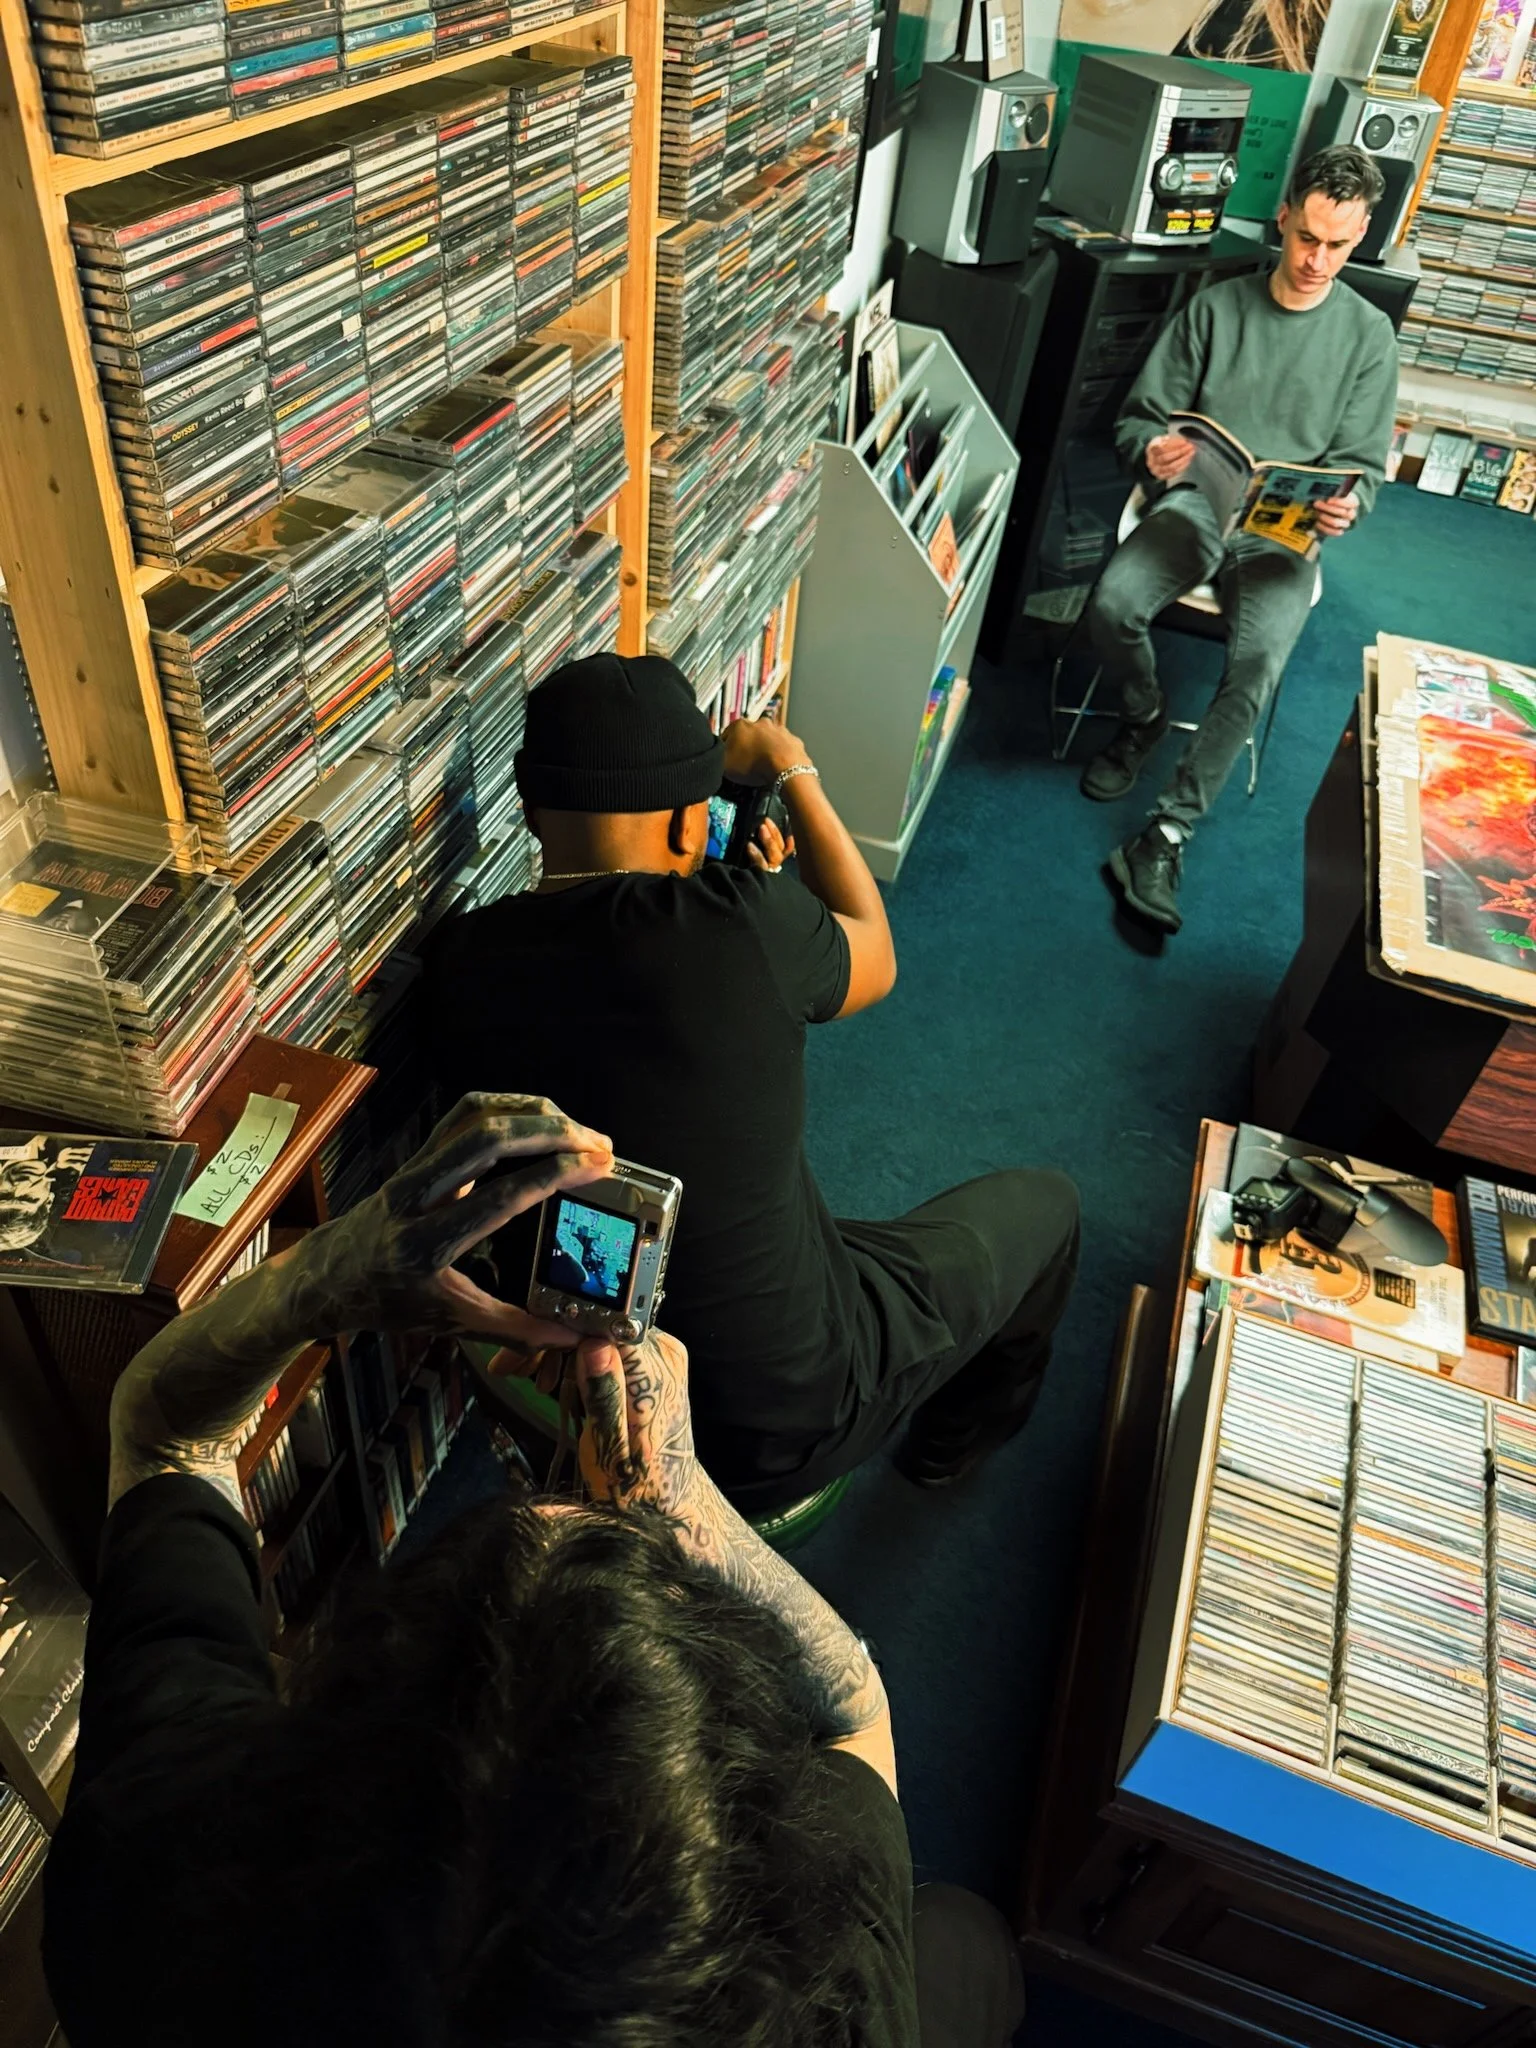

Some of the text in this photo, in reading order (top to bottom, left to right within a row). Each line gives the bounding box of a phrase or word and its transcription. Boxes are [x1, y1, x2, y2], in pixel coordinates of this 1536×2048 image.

[169, 420, 201, 443] ODYSSEY
[202, 407, 221, 424] Kevin
[36, 863, 107, 893] WOW
[75, 1175, 149, 1204] GAMES
[200, 1183, 231, 1217] ALL
[60, 1195, 140, 1222] PATRIOT
[1464, 1175, 1509, 1291] NEIL DIAMOND
[1479, 1285, 1536, 1335] STA
[622, 1349, 656, 1413] WBC
[27, 1701, 62, 1752] Compact
